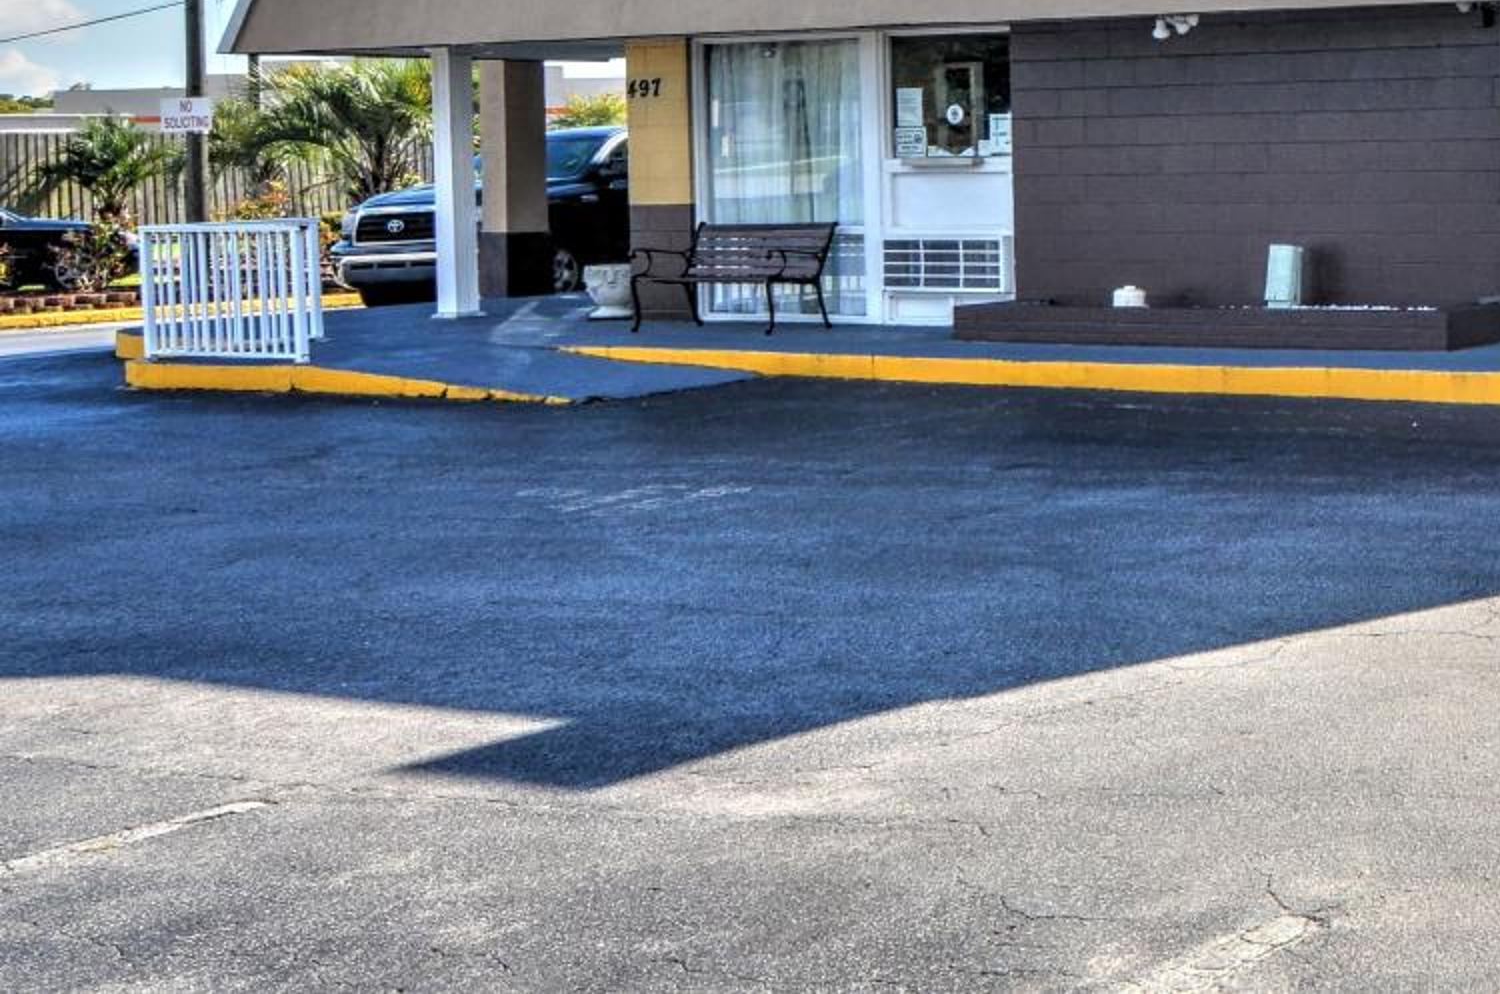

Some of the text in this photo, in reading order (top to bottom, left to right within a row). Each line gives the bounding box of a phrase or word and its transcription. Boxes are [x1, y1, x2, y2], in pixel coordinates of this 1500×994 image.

[627, 77, 661, 98] 497
[179, 99, 192, 112] NO
[164, 116, 209, 128] SOLICITING
